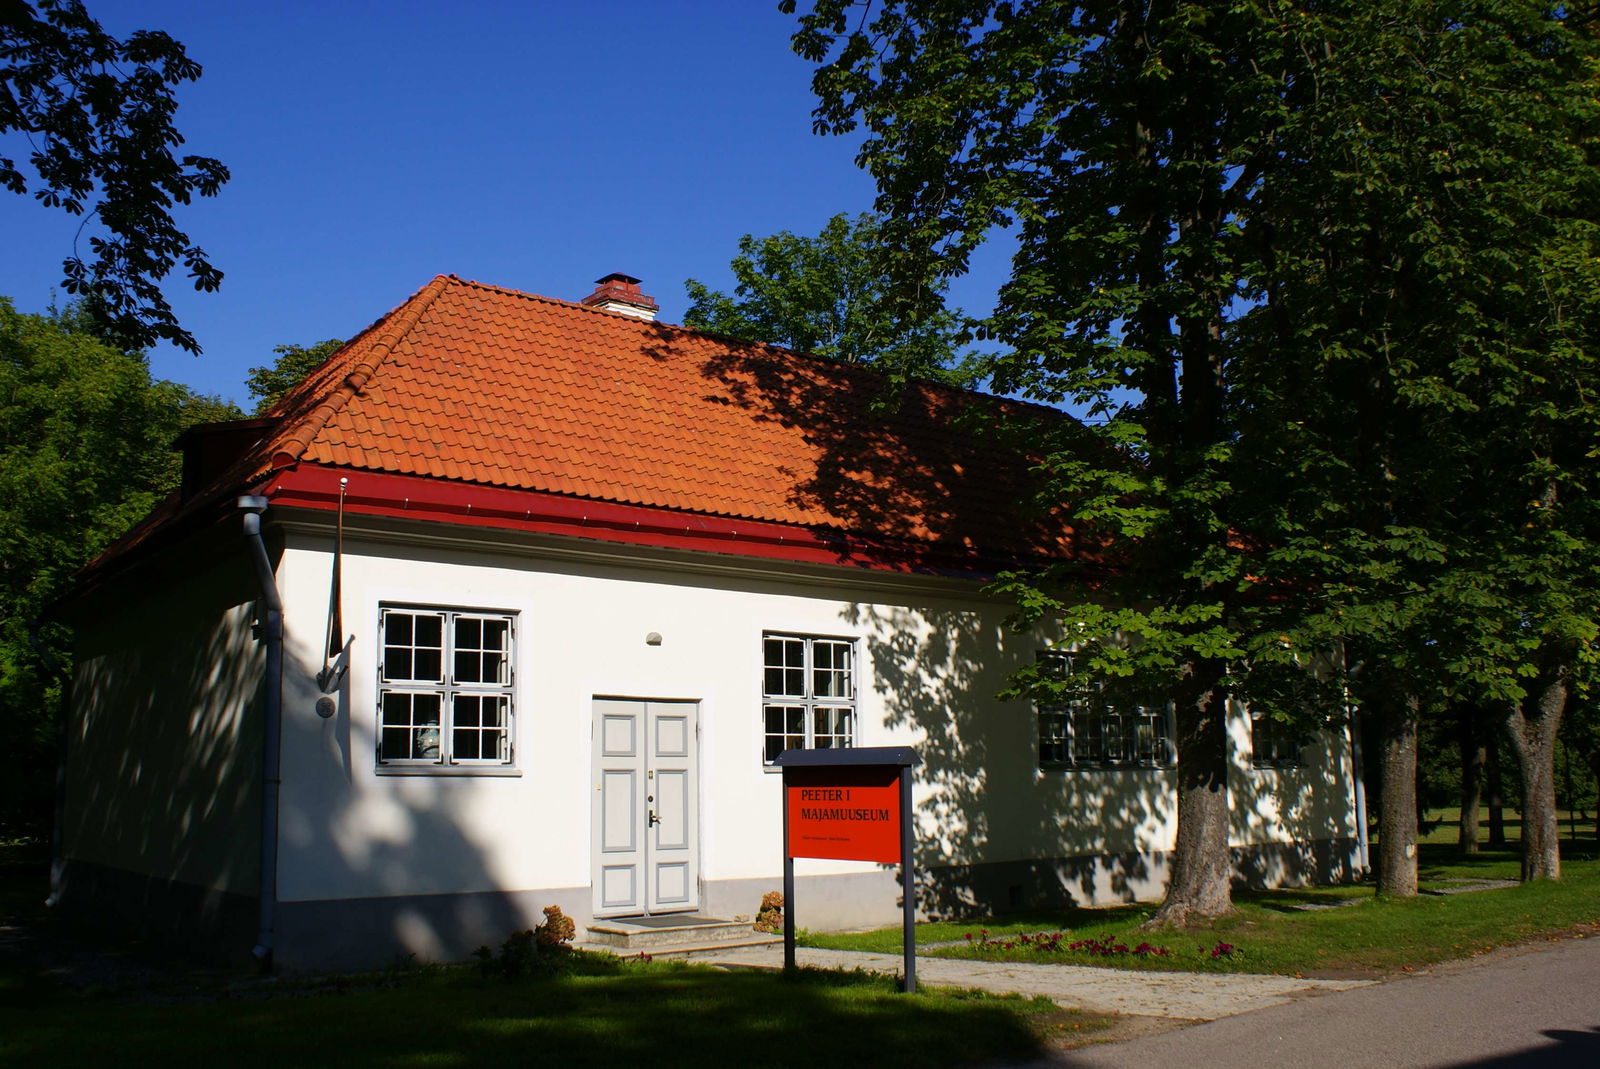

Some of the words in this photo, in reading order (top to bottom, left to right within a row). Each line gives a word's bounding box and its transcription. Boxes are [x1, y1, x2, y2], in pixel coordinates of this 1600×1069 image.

[801, 789, 843, 801] PEETER
[846, 790, 850, 801] I
[801, 808, 889, 821] MAJAMUUSEUM
